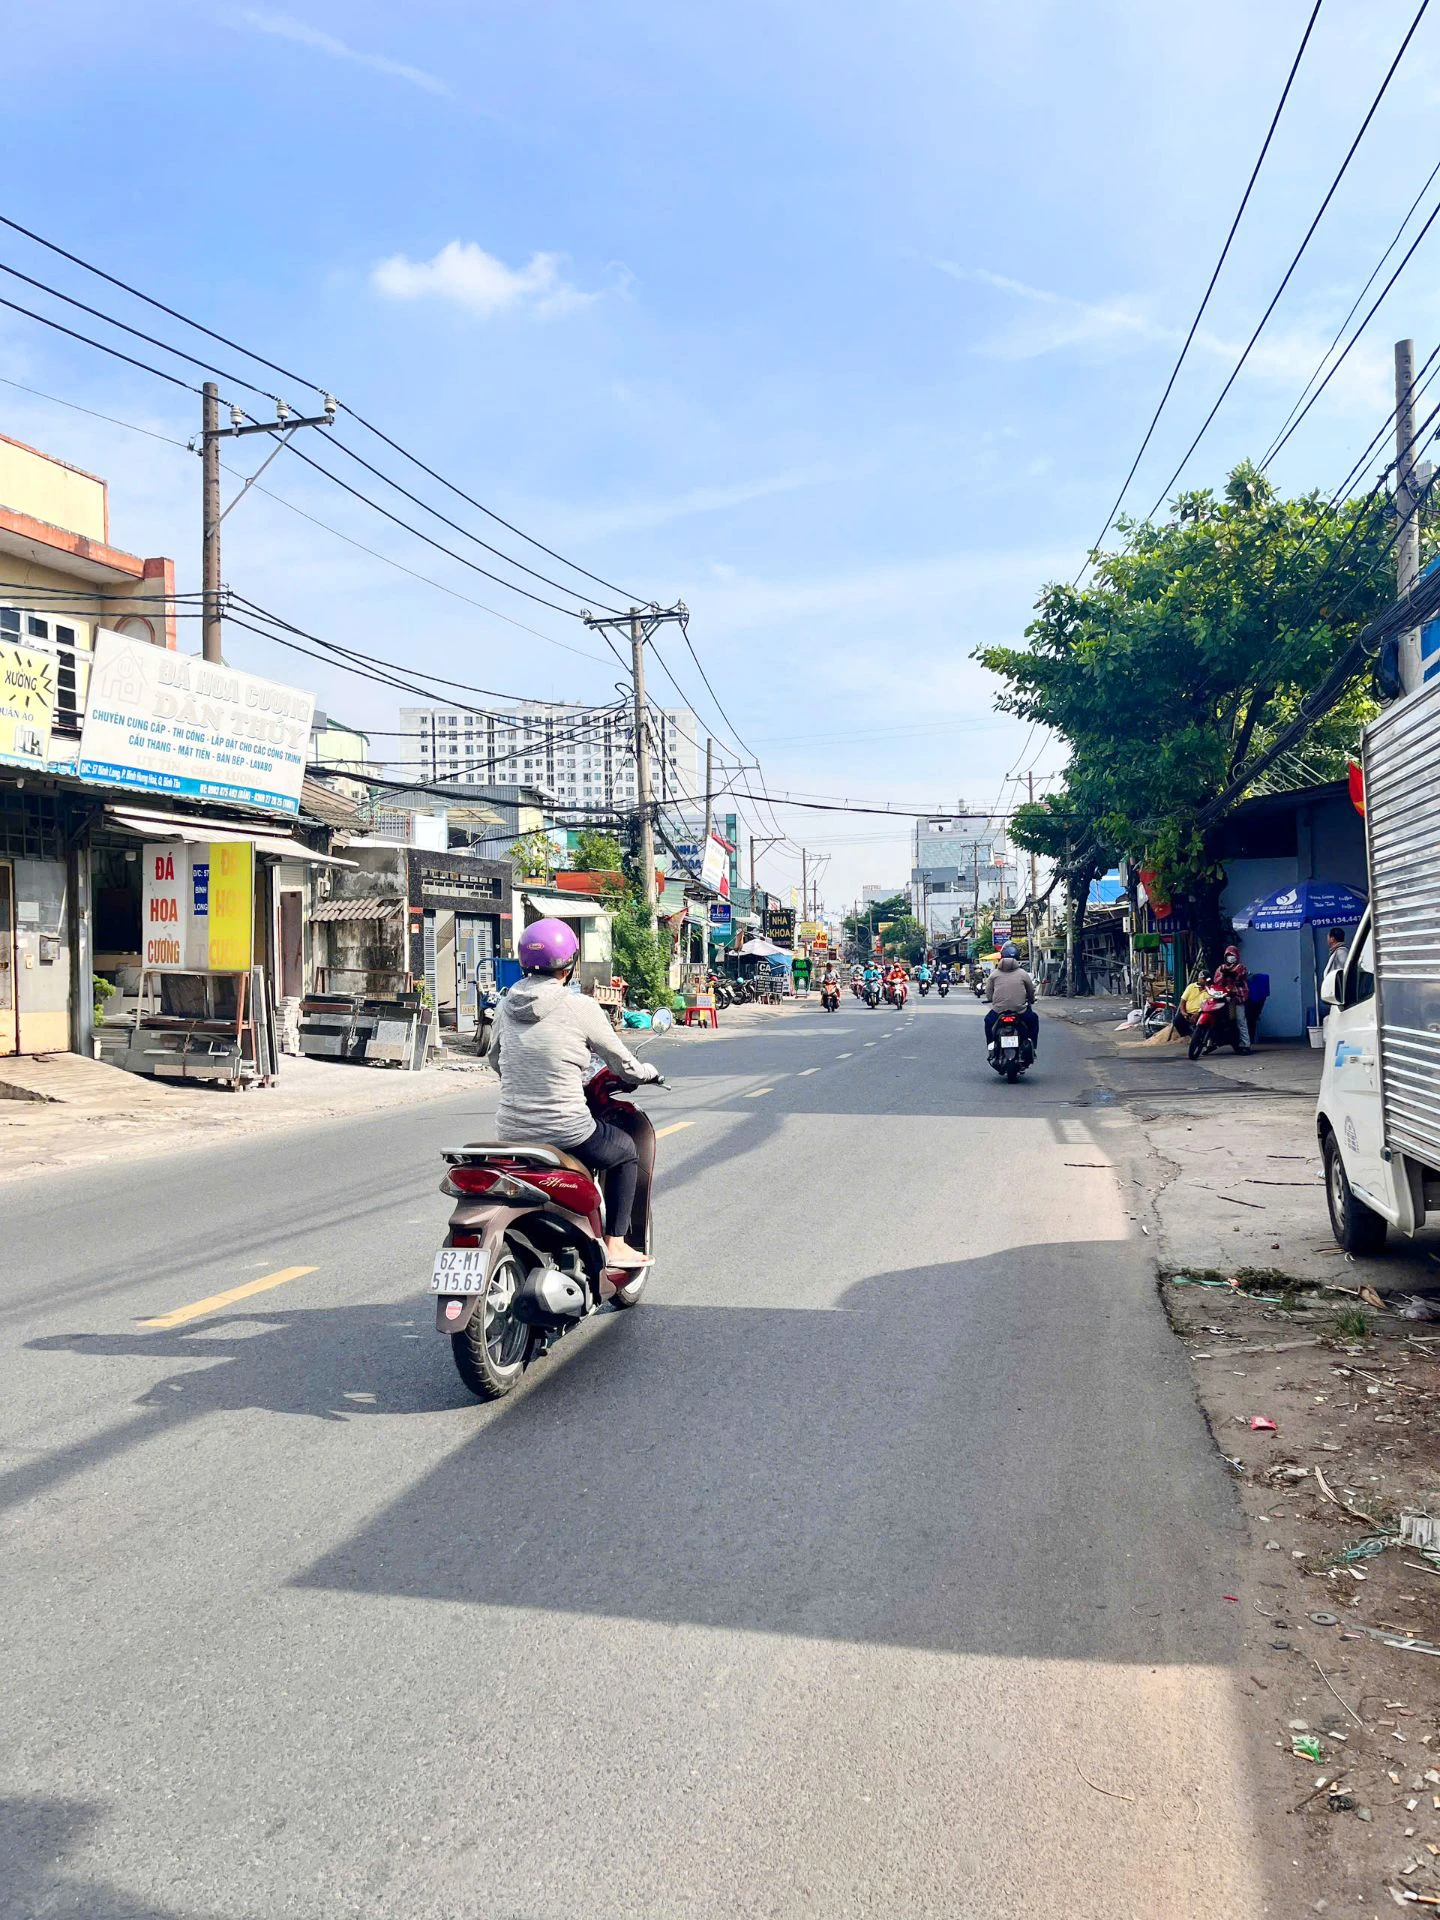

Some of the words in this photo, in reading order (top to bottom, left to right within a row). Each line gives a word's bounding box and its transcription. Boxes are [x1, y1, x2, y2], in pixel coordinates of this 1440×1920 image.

[195, 669, 239, 703] HOA
[92, 709, 125, 726] CHUYÊN
[127, 716, 148, 731] CUNG
[150, 721, 166, 734] CẤP
[172, 727, 184, 738] THI
[185, 729, 205, 743] CÔNG
[225, 738, 238, 749] ĐẶT
[239, 741, 252, 752] CHO
[253, 743, 266, 756] CÁC
[267, 746, 283, 760] CÔNG
[147, 738, 171, 753] THANG
[177, 743, 194, 758] MẶT
[249, 759, 273, 772] LAVABO
[155, 852, 175, 880] ĐÁ
[149, 898, 178, 923] HOA
[194, 903, 208, 911] LONG
[769, 928, 791, 938] KHOA
[771, 916, 788, 925] NHA
[147, 938, 180, 964] CƯƠNG
[440, 1252, 480, 1271] 62-M1
[432, 1272, 483, 1292] 515.63
